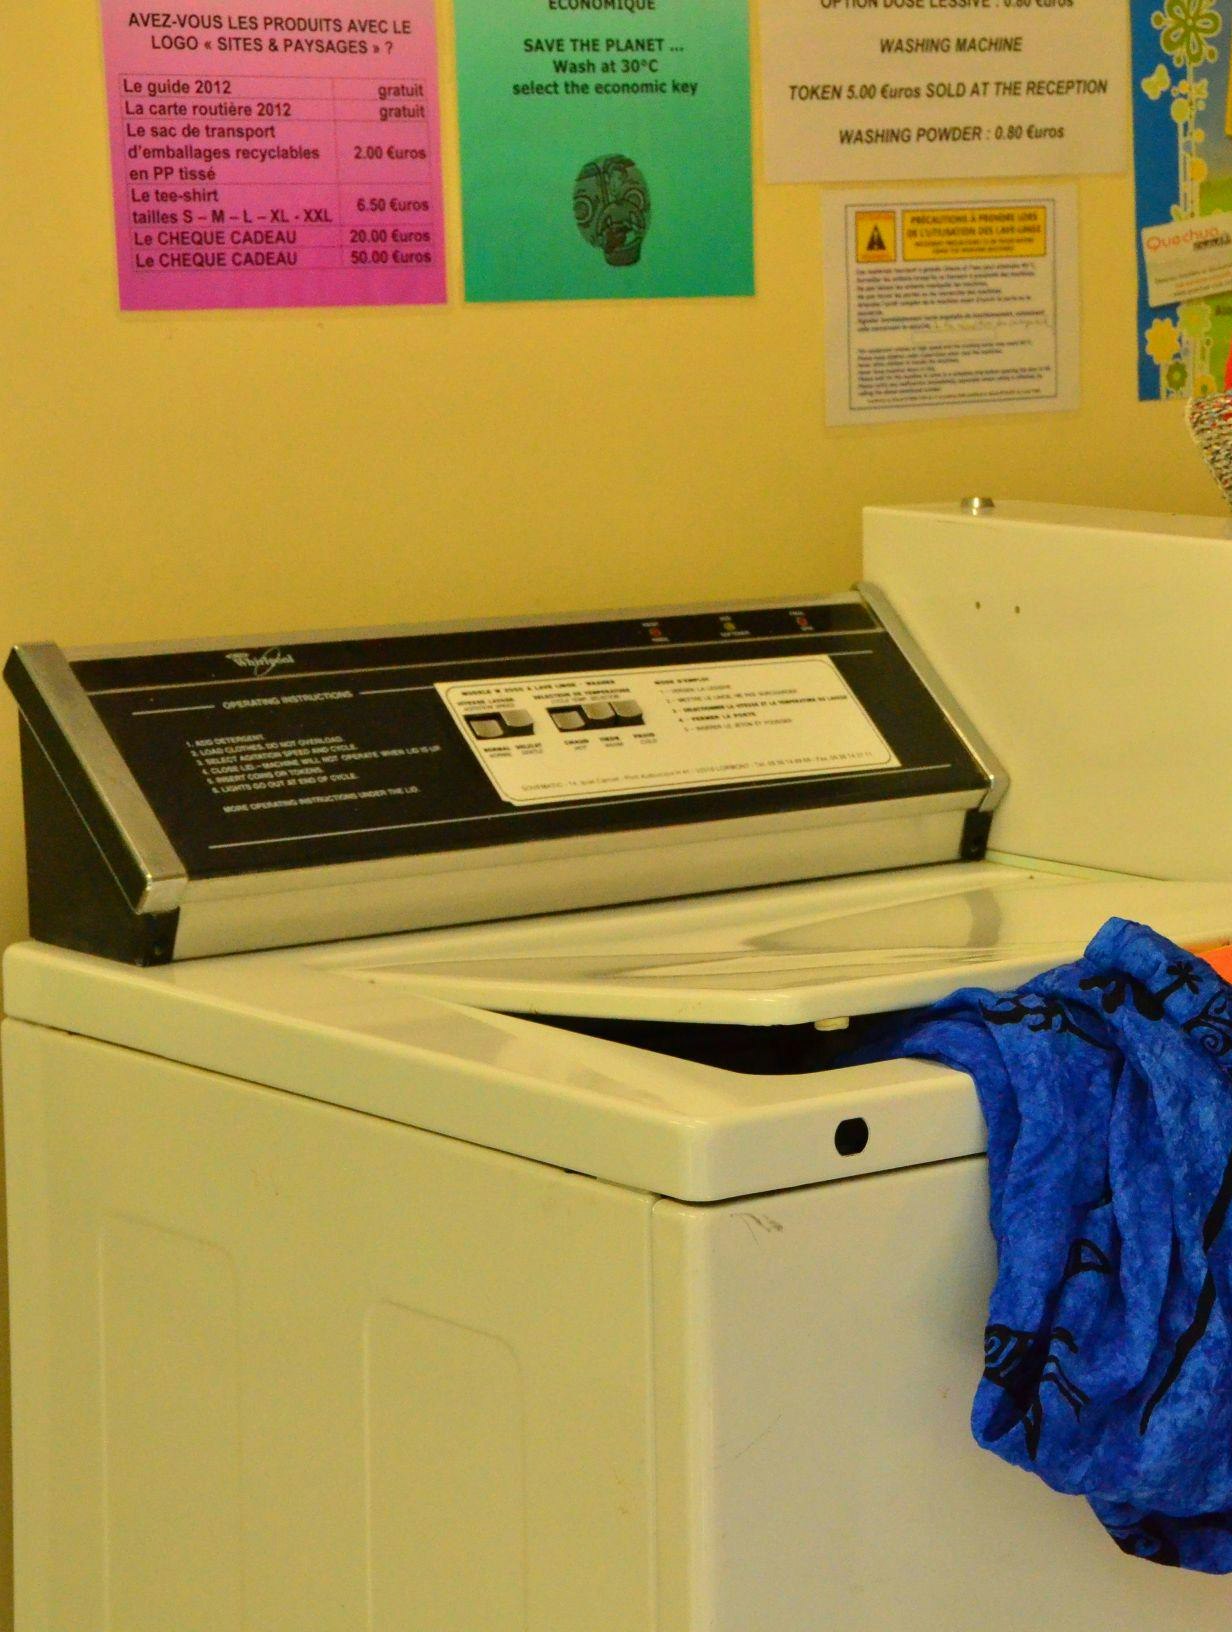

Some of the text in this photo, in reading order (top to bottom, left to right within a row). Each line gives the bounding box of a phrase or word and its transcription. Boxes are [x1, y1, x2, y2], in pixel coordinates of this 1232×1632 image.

[820, 0, 887, 9] OPTION
[891, 0, 926, 9] DOSE
[929, 0, 991, 8] LESSIVE
[129, 13, 411, 34] AVEZ-VOUS LES PRODUITS AVEC LE
[151, 35, 198, 50] LOGO
[217, 37, 263, 52] SITES
[269, 39, 279, 52] &
[283, 39, 368, 54] PAYSAGES
[386, 41, 393, 54] ?
[524, 38, 564, 52] SAVE
[570, 39, 600, 52] THE
[605, 38, 664, 52] PLANET
[880, 36, 1023, 54] WASHING MACHINE
[554, 59, 658, 73] Wash at 30°C
[123, 78, 231, 96] Le guide 2012
[378, 84, 424, 100] gratuit
[512, 80, 698, 95] select the economic key
[789, 79, 1107, 101] TOKEN 5.00 €uros SOLD AT THE RECEPTION
[125, 100, 292, 117] La carte routière 2012
[379, 106, 425, 122] gratuit
[126, 122, 275, 141] Le sac de transport
[839, 128, 912, 144] WASHING
[916, 126, 981, 142] POWDER
[995, 126, 1022, 140] 0.80
[1027, 124, 1064, 139] €uros
[128, 144, 320, 162] d'emballages recyclables
[354, 145, 427, 160] 2.00 €uros
[129, 166, 216, 181] en PP tissé
[131, 188, 219, 203] Le tee-shirt
[356, 198, 429, 212] 6.50 €uros
[132, 209, 178, 224] tailles
[183, 208, 193, 224] S
[211, 208, 225, 223] M
[243, 208, 252, 223] L
[270, 208, 289, 223] XL
[303, 208, 333, 223] XXL
[134, 230, 296, 247] Le CHEQUE CADEAU
[350, 229, 431, 243] 20.00 €uros
[135, 251, 297, 268] Le CHEQUE CADEAU
[351, 249, 432, 264] 50.00 €uros
[222, 691, 354, 710] OPERATING INSTRUCTIONS
[205, 756, 238, 765] SELECT
[311, 746, 329, 754] AND
[210, 765, 239, 774] CLOSE
[220, 784, 252, 792] LIGHTS
[267, 780, 285, 788] OUT
[222, 804, 249, 813] MORE
[249, 799, 298, 809] OPERATING
[298, 792, 358, 805] INSTRUCTIONS
[357, 789, 387, 798] UNDER
[387, 787, 404, 795] THE
